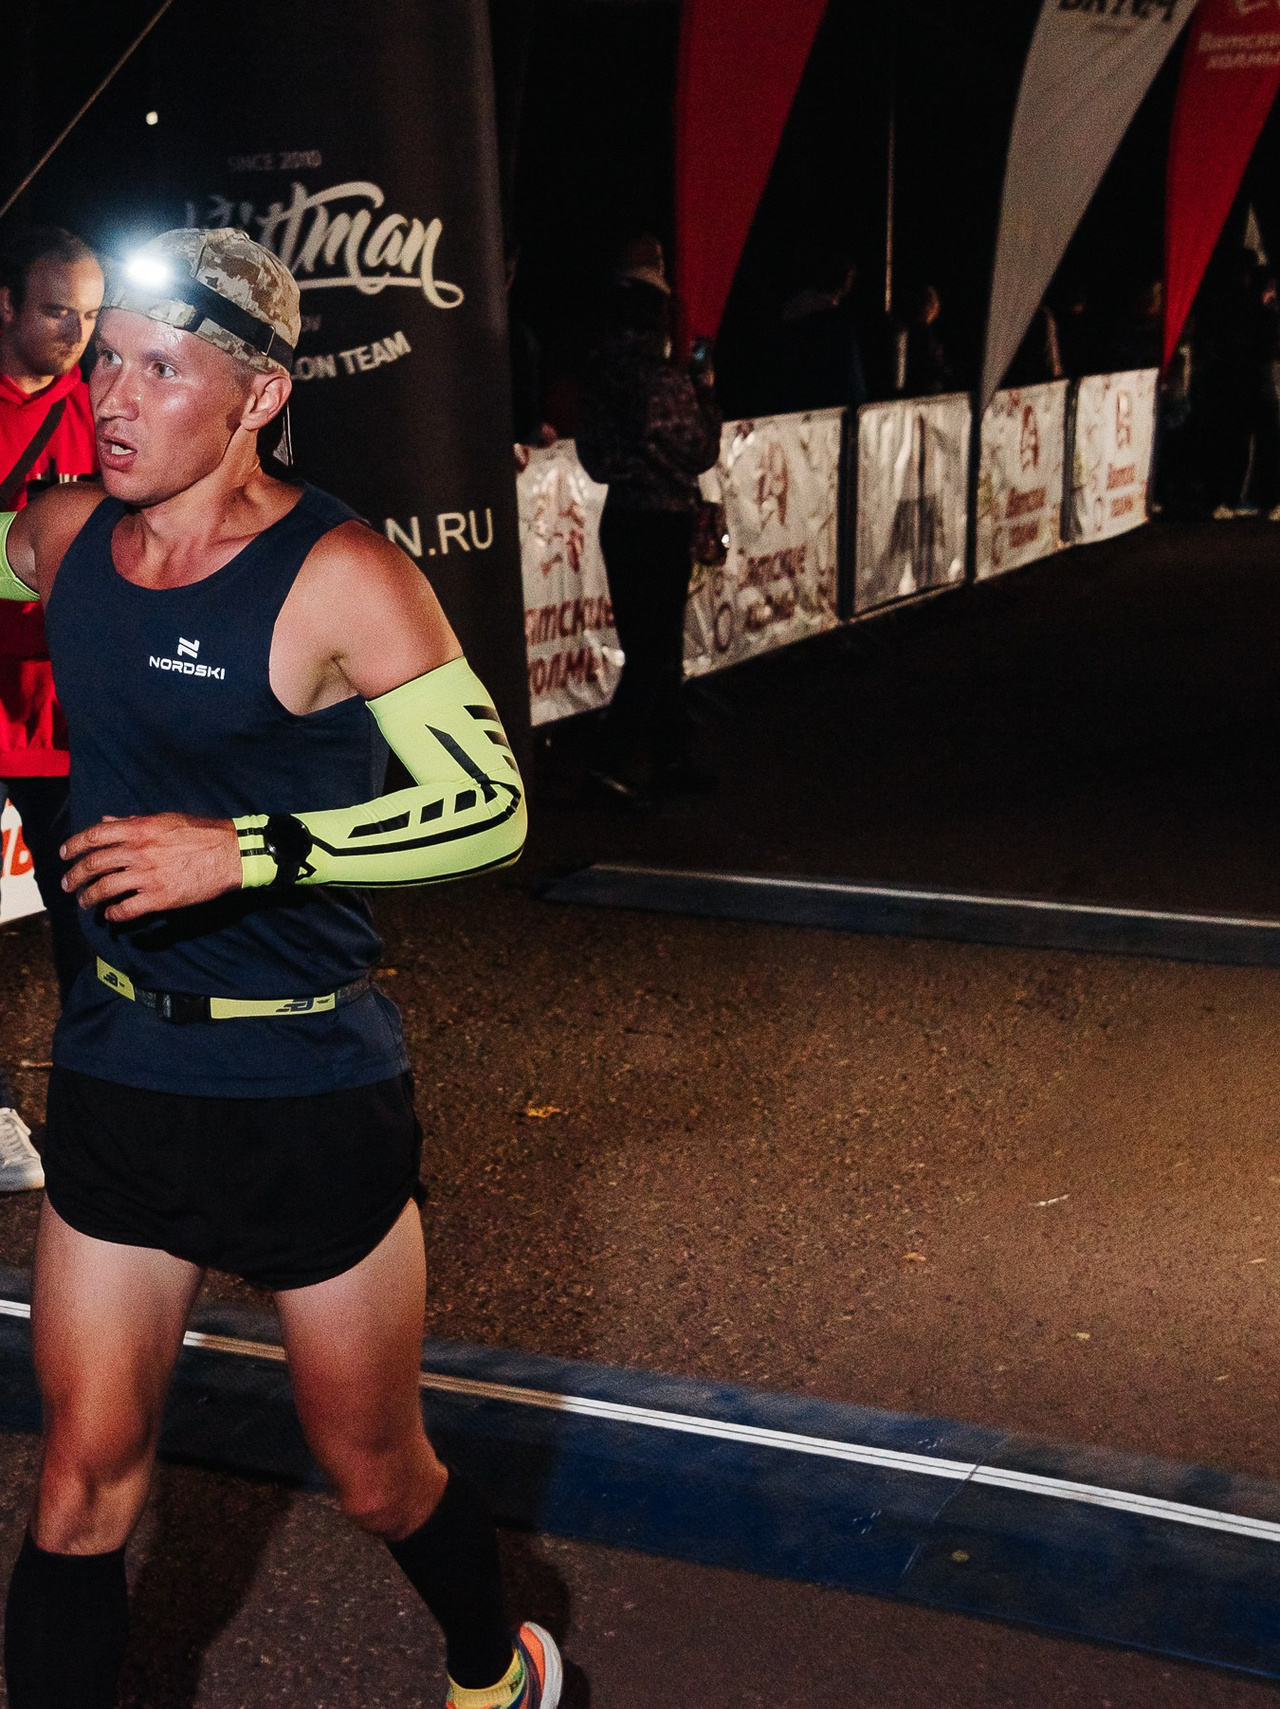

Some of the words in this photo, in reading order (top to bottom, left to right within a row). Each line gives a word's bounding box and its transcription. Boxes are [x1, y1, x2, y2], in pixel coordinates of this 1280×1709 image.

[338, 330, 412, 375] TEAM
[384, 507, 493, 557] N.RU
[149, 655, 226, 680] NORDSKI
